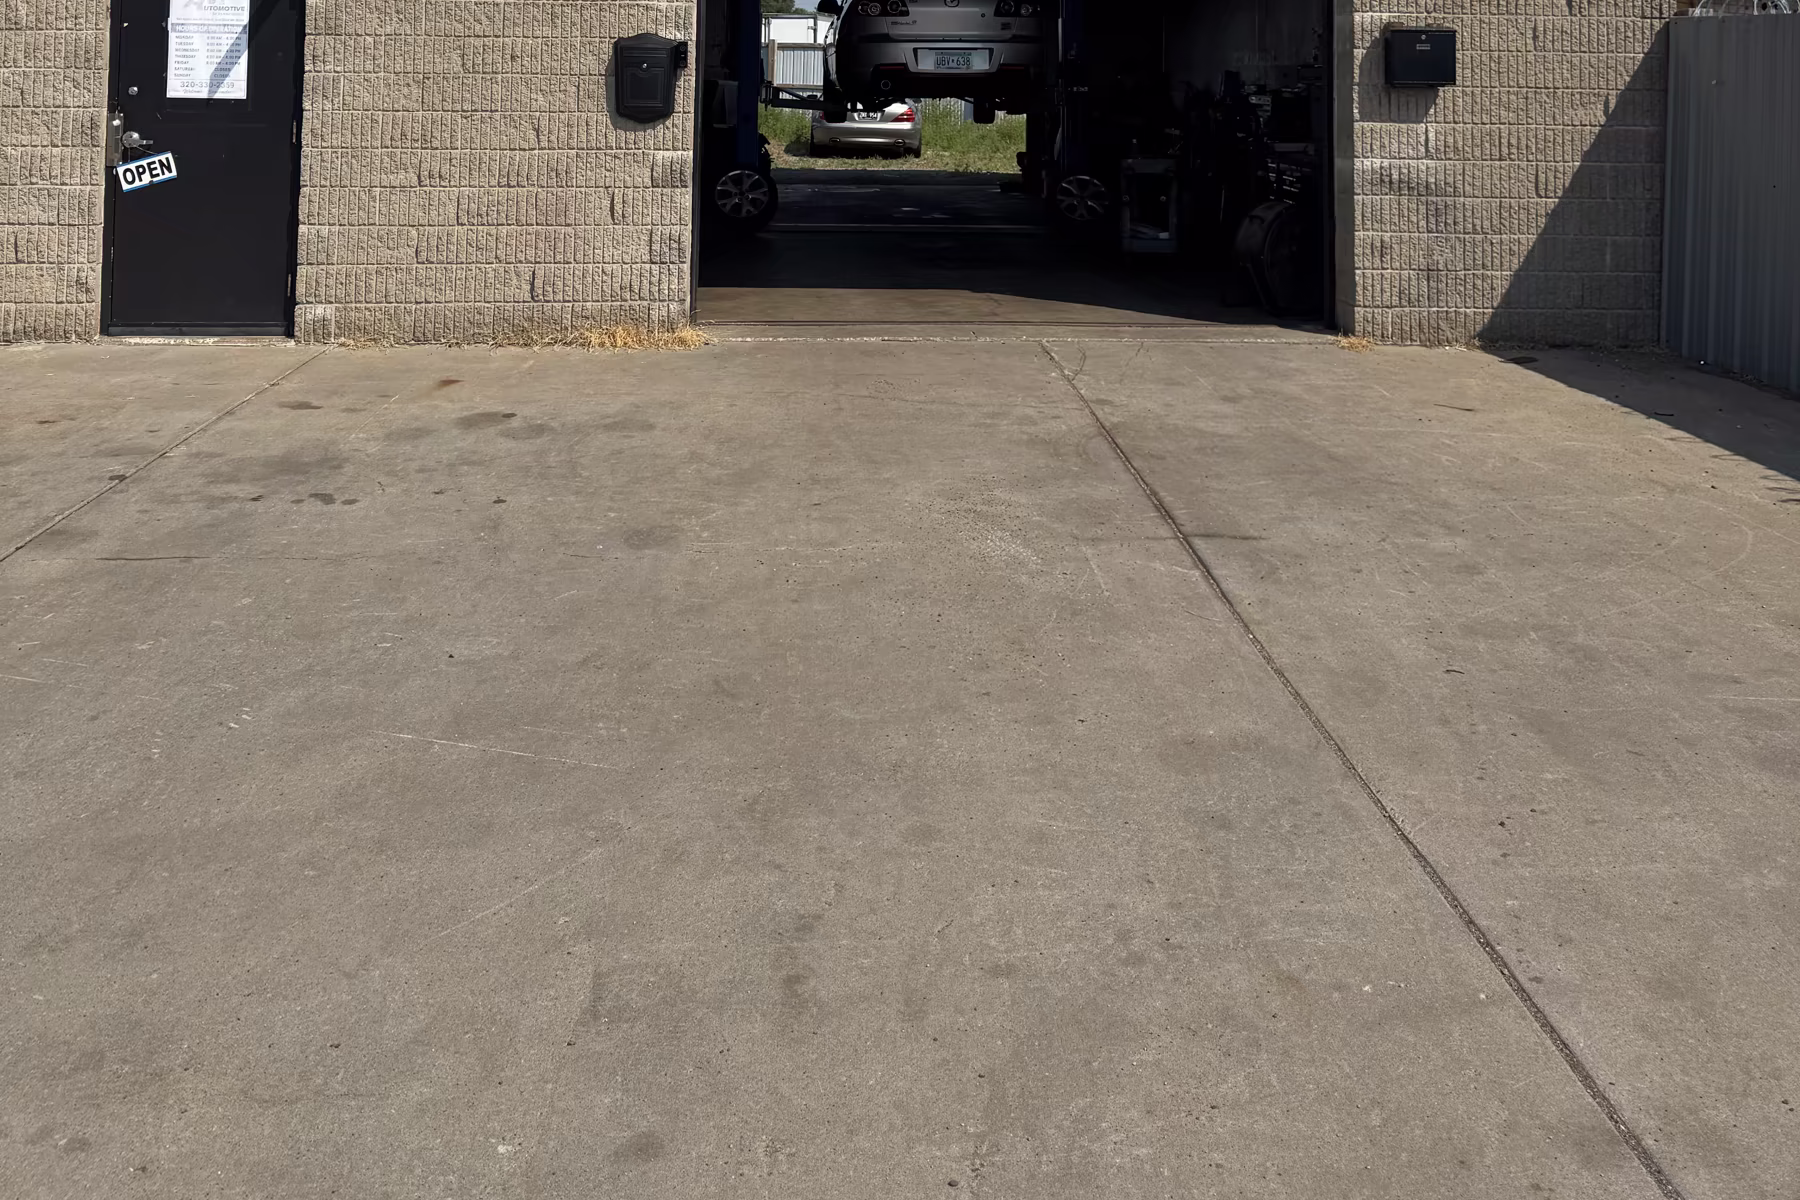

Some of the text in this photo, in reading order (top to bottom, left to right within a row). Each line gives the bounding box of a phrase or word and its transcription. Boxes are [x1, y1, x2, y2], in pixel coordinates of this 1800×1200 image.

[175, 25, 198, 33] HOURS
[936, 56, 971, 66] UBV 638
[122, 156, 173, 186] OPEN
